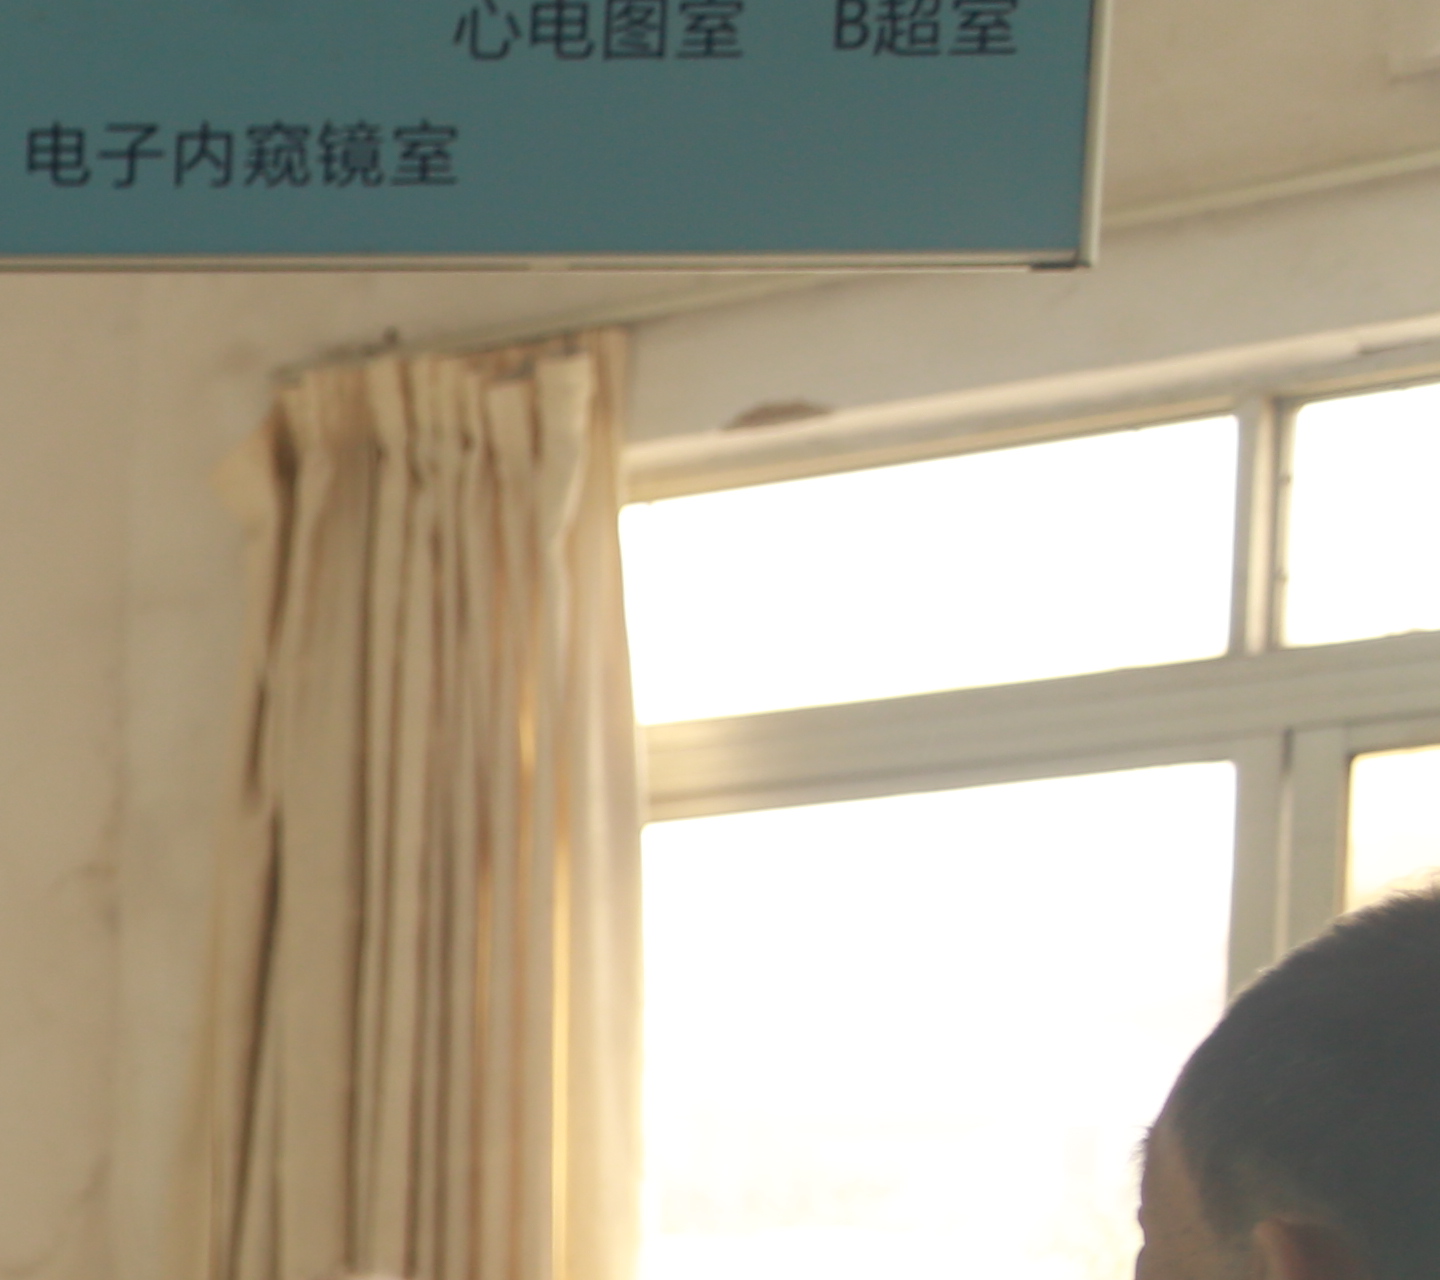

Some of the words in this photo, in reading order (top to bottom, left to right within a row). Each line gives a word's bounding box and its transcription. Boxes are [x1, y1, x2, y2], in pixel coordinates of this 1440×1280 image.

[453, 0, 745, 61] 心电图室
[833, 0, 1018, 57] B超室
[24, 120, 460, 190] 电子内窥镜室
